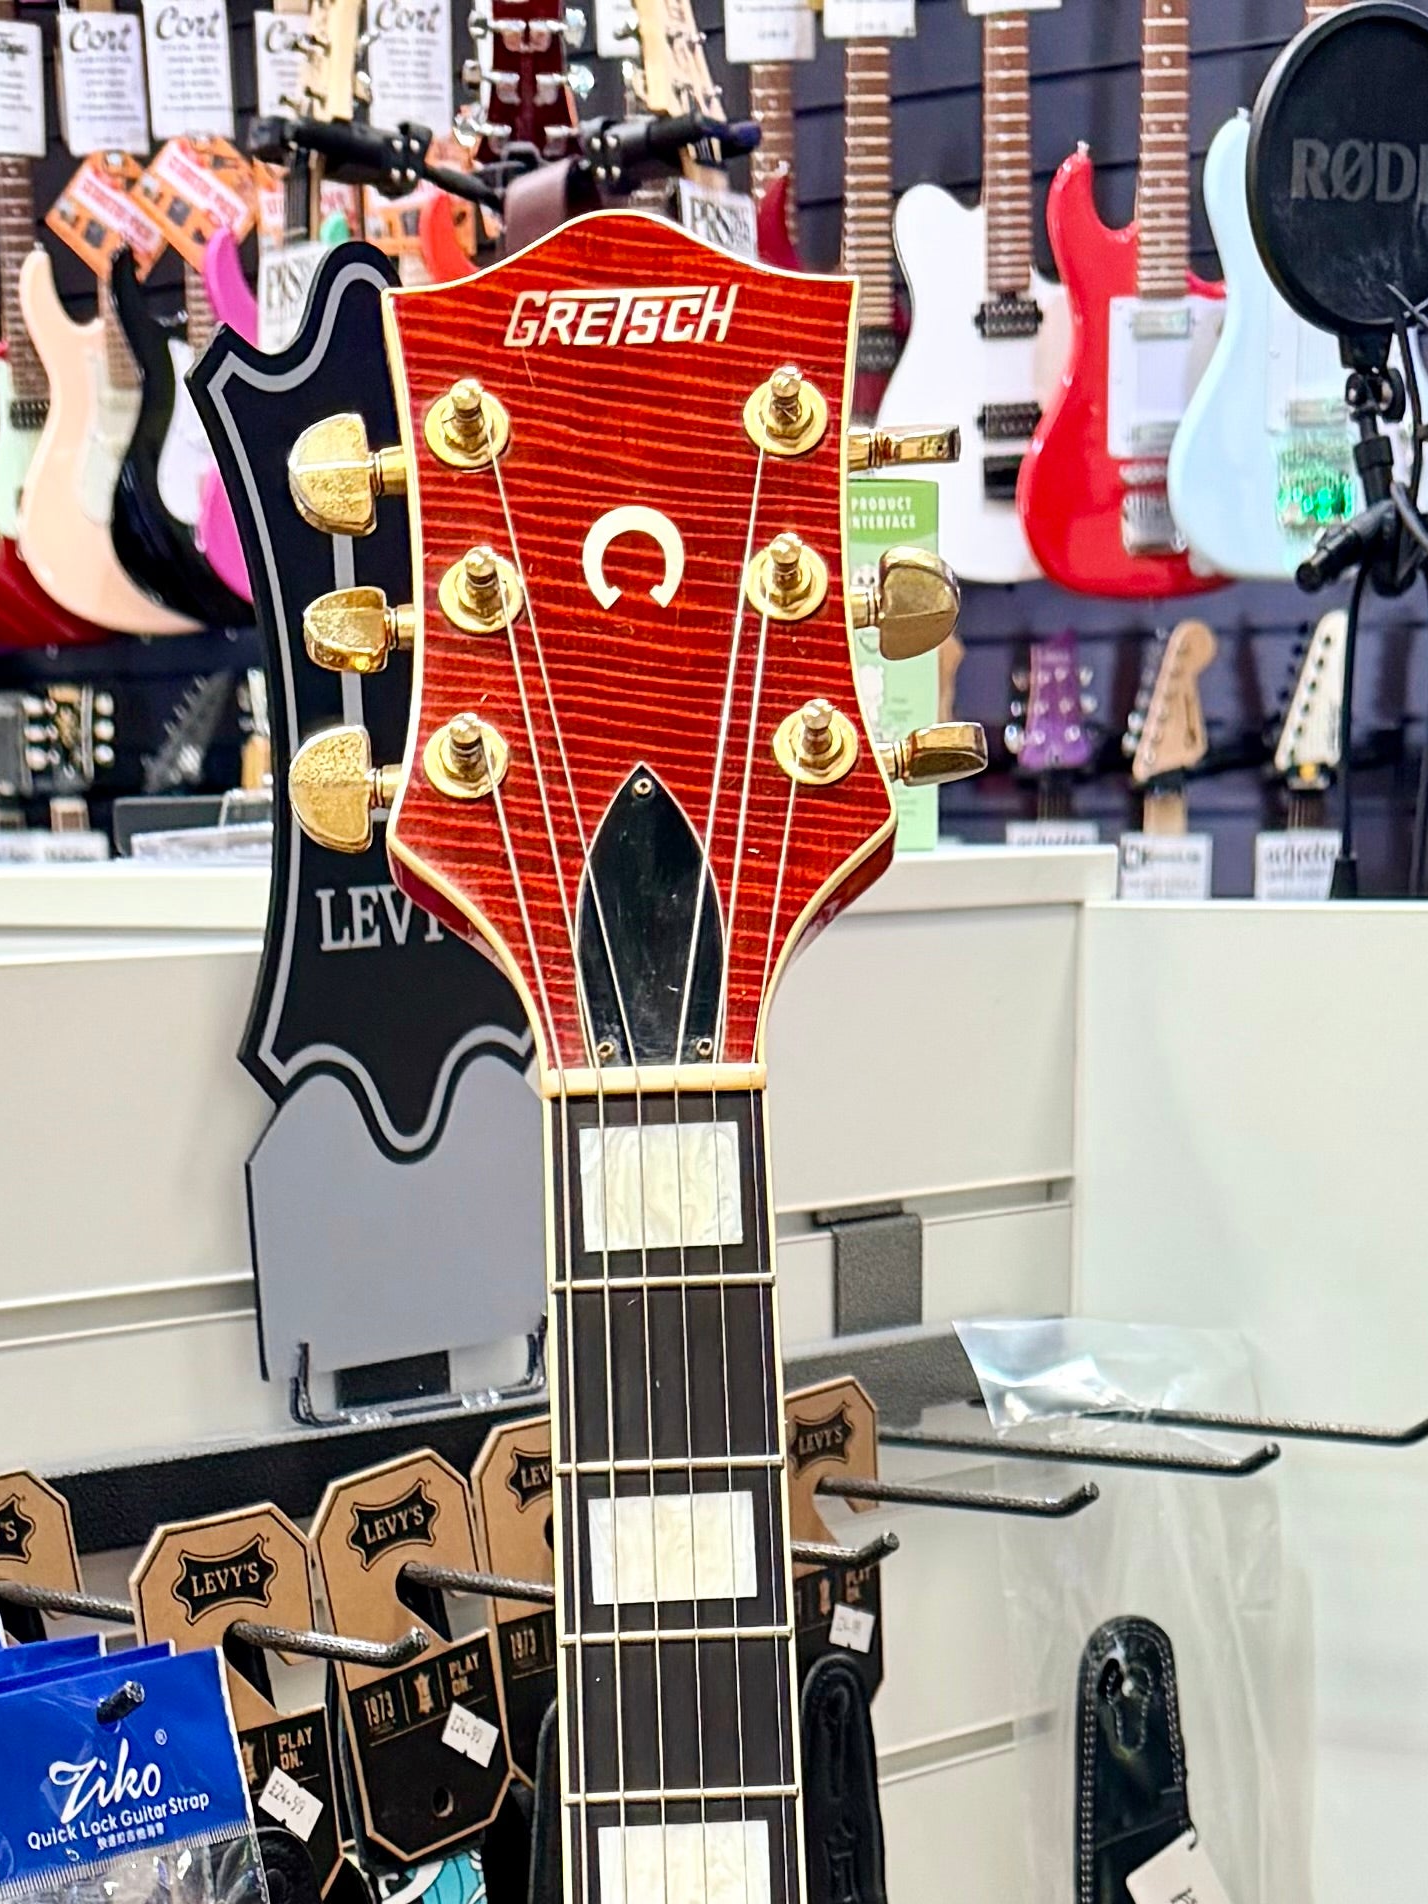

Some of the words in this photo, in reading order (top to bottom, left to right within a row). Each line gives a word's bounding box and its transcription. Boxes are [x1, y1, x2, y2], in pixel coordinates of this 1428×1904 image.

[69, 20, 132, 53] Cort
[155, 6, 221, 40] Cort
[503, 283, 740, 348] GRETSCH
[851, 496, 913, 512] PRODUCT
[849, 513, 917, 530] NTERFACE
[797, 1427, 844, 1456] LEVY'S
[362, 1503, 425, 1545] LEVY'S
[189, 1561, 260, 1598] LEVY'S
[509, 1628, 536, 1660] 1973
[448, 1652, 480, 1677] PLAY
[363, 1690, 395, 1728] 1973
[277, 1726, 313, 1753] PLAY
[48, 1737, 162, 1824] Ziko
[27, 1824, 78, 1851] Quick
[79, 1813, 117, 1838] Lock
[120, 1803, 168, 1827] Guitar
[169, 1792, 210, 1816] Strap
